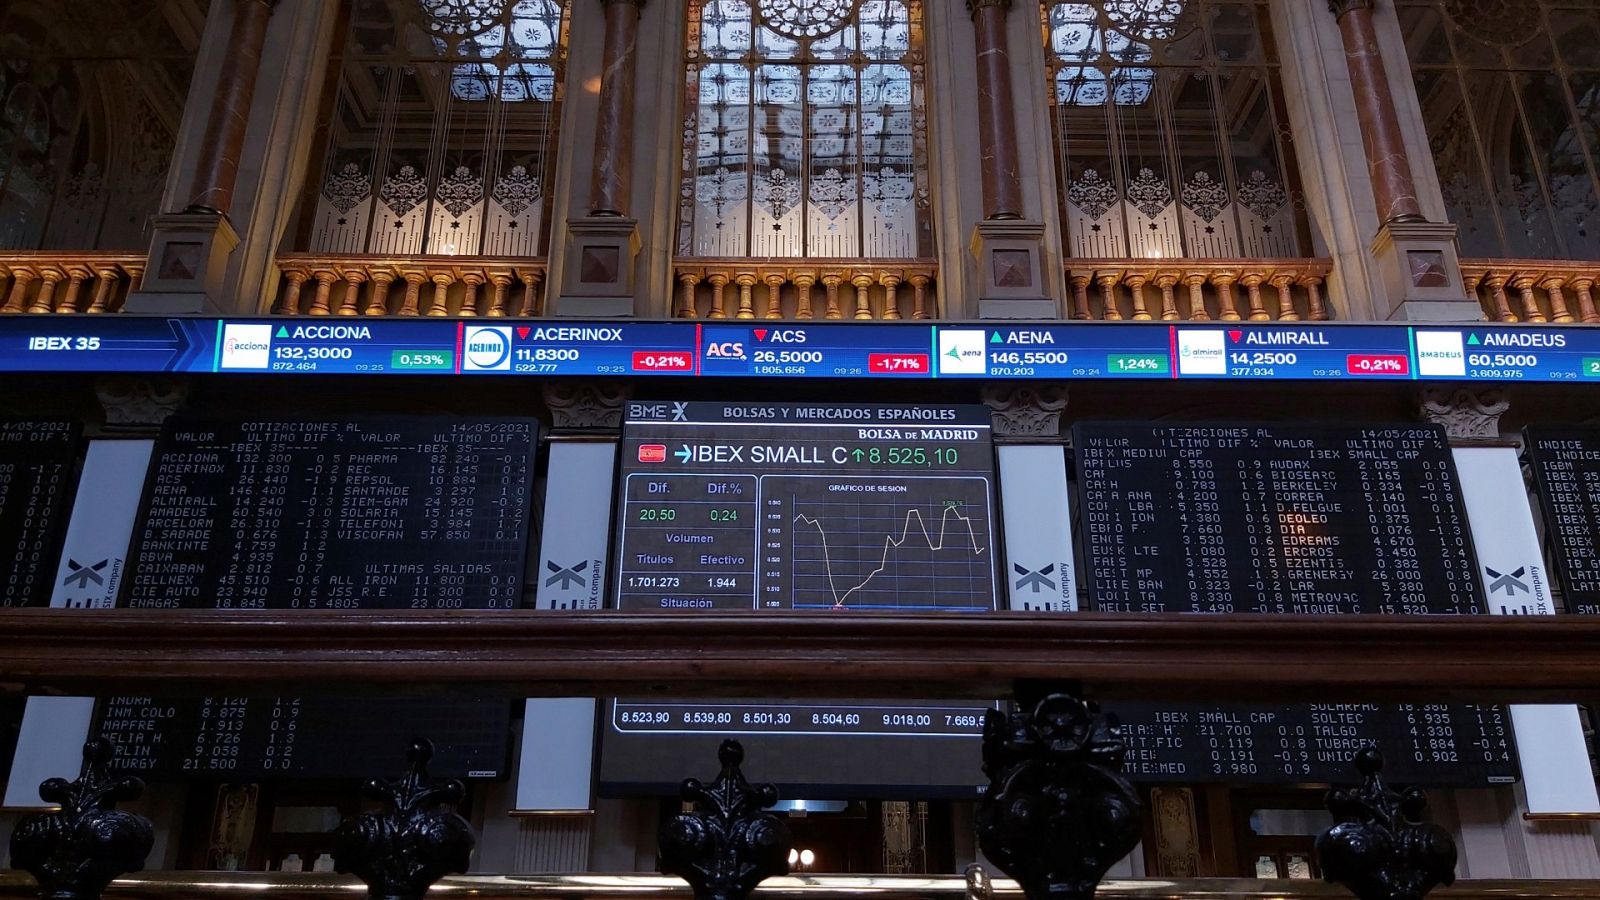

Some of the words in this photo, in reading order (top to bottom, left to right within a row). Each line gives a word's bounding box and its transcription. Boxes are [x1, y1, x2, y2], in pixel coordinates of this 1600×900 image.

[294, 326, 371, 340] ACCIONA
[533, 328, 623, 341] ACERINOX
[771, 329, 805, 343] ACS
[1007, 330, 1054, 345] AENA
[1245, 331, 1329, 345] ALMIRALL
[28, 337, 72, 350] IBEX
[75, 337, 100, 350] 35
[1483, 333, 1566, 347] AMADEUS
[234, 342, 268, 350] acciona
[468, 343, 501, 353] ACERINOX
[273, 347, 352, 360] 132,3000
[515, 349, 580, 361] 11,8300
[754, 351, 822, 365] 26,5000
[962, 349, 982, 357] aena
[400, 354, 444, 366] 0,53%
[639, 355, 686, 368] -0,21%
[876, 357, 920, 370] -1,71%
[990, 352, 1068, 365] 146,5500
[1230, 352, 1297, 365] 14,2500
[1468, 354, 1537, 367] 60,5000
[272, 362, 317, 371] 872.464
[515, 364, 558, 373] 522.777
[1117, 358, 1158, 370] 1,24%
[1354, 359, 1401, 371] -0,21%
[755, 366, 807, 376] 1.805.656
[990, 367, 1035, 376] 870.203
[1231, 367, 1274, 376] 377.934
[1470, 370, 1523, 378] 3.609.975
[629, 404, 667, 418] BME
[723, 407, 775, 418] BOLSAS
[781, 407, 790, 418] Y
[795, 407, 871, 419] MERCADOS
[877, 407, 956, 420] ESPAÑOLES
[241, 422, 339, 432] COTIZACIONES
[346, 423, 361, 432] AL
[451, 423, 530, 433] 14/05/2021
[175, 433, 216, 442] VALOR
[247, 433, 296, 442] ULTIMO
[303, 433, 328, 442] DIF
[360, 433, 401, 443] VALOR
[434, 434, 482, 443] ULTIMO
[489, 434, 514, 443] DIF
[858, 429, 901, 440] BOLSA
[905, 432, 918, 440] DE
[920, 429, 979, 441] MADRID
[1361, 429, 1438, 439] 14/05/2021
[1274, 439, 1315, 449] VALOR
[1345, 440, 1394, 449] ULTIMO
[1402, 440, 1425, 449] DIF
[1538, 440, 1583, 450] INDICE
[161, 453, 219, 463] ACCIONA
[349, 454, 399, 464] PHARMA
[692, 445, 744, 463] IBEX
[750, 445, 824, 463] SMALL
[831, 446, 848, 464] C
[869, 447, 958, 467] 8.525,10
[1348, 450, 1389, 459] SMALL
[1396, 450, 1420, 459] CAP
[159, 464, 225, 473] ACERINOX
[347, 465, 372, 474] REC
[1172, 460, 1213, 468] 8.550
[1270, 460, 1311, 469] AUDAX
[1543, 461, 1574, 470] IGBM
[157, 475, 181, 484] ACS
[346, 476, 394, 485] REPSOL
[1545, 472, 1576, 481] IBEX
[154, 486, 188, 495] AENA
[344, 486, 410, 496] SANTANDE
[648, 482, 670, 494] Dif.
[707, 483, 742, 495] Dif.%
[864, 485, 876, 493] DE
[152, 497, 217, 506] ALMIRALL
[342, 497, 409, 507] SIEM-GAM
[1275, 492, 1324, 502] CORREA
[149, 508, 208, 517] AMADEUS
[340, 508, 399, 518] SOLARIA
[147, 519, 214, 528] ARCELORM
[339, 519, 405, 529] TELEFONI
[1278, 514, 1328, 524] DEOLEO
[337, 530, 404, 540] VISCOFAN
[1279, 525, 1306, 535] DIA
[665, 533, 714, 544] Volumen
[1282, 536, 1340, 546] EDREAMS
[142, 541, 209, 551] BANKINTE
[234, 542, 276, 551] 4.759
[1284, 547, 1334, 557] ERCROS
[139, 553, 173, 562] BBVA
[232, 553, 274, 562] 4.935
[700, 554, 745, 565] Efectivo
[137, 564, 205, 574] CAIXABAN
[229, 564, 272, 574] 2.812
[365, 564, 425, 574] ULTIMAS
[433, 564, 492, 574] SALIDAS
[107, 558, 123, 594] company
[134, 575, 194, 585] CELLNEX
[329, 575, 354, 585] ALL
[364, 576, 398, 585] IRON
[591, 559, 603, 596] company
[1061, 562, 1070, 598] company
[628, 577, 680, 588] 1.701.273
[707, 577, 737, 588] 1.944
[1289, 582, 1315, 591] LAR
[1529, 565, 1543, 601] company
[132, 587, 157, 597] CIE
[166, 587, 200, 597] AUTO
[328, 587, 353, 597] JSS
[129, 599, 181, 608] ENAGAS
[660, 597, 713, 608] Situación
[201, 708, 247, 718] 8.875
[1154, 712, 1189, 723] IBEX
[1198, 712, 1241, 723] SMALL
[1250, 713, 1276, 723] CAP
[621, 712, 670, 724] 8.523,90
[683, 712, 732, 724] 8.539,80
[743, 712, 791, 725] 8.501,30
[811, 713, 860, 725] 8.504,60
[882, 714, 931, 726] 9.018,00
[1311, 713, 1364, 725] SOLTEC
[1407, 713, 1451, 725] 6.935
[102, 720, 156, 731] MAPFRE
[1313, 725, 1357, 736] TALGO
[1409, 726, 1453, 737] 4.330
